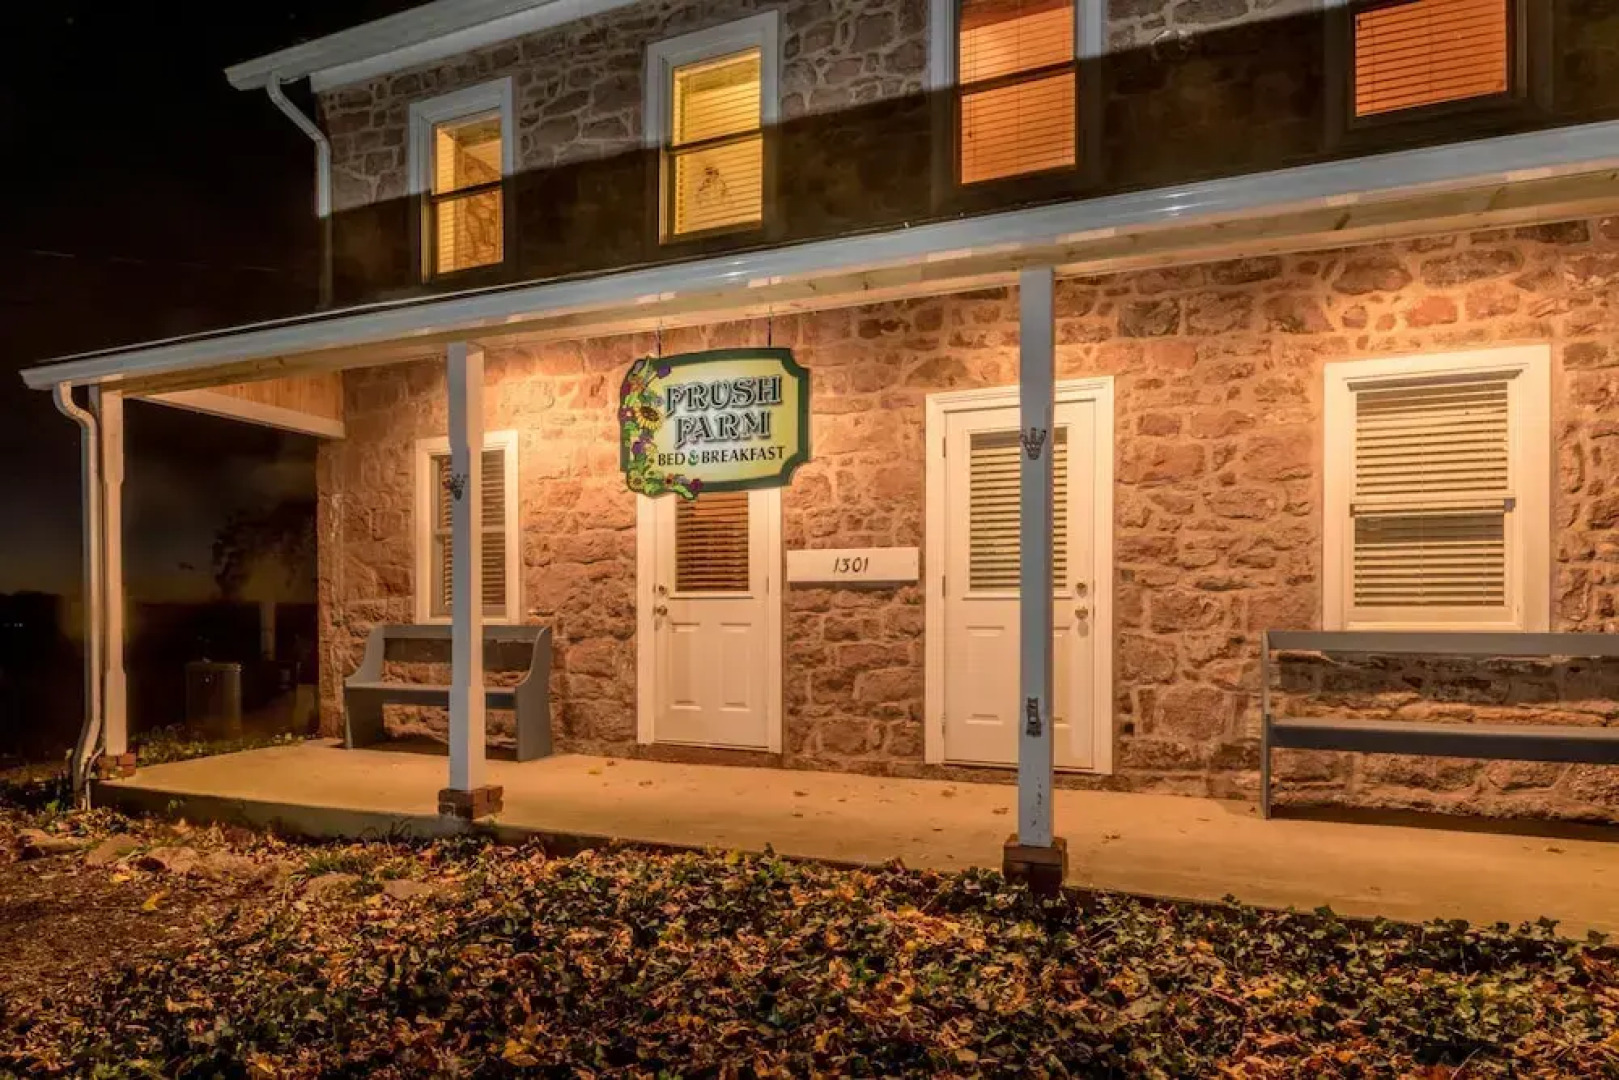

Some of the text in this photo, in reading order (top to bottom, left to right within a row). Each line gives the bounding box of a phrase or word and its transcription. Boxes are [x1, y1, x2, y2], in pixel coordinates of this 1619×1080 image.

[664, 374, 782, 418] FRUSH
[674, 409, 771, 450] FARM
[658, 445, 786, 467] BED & BREAKFAST
[833, 556, 869, 574] 1301
